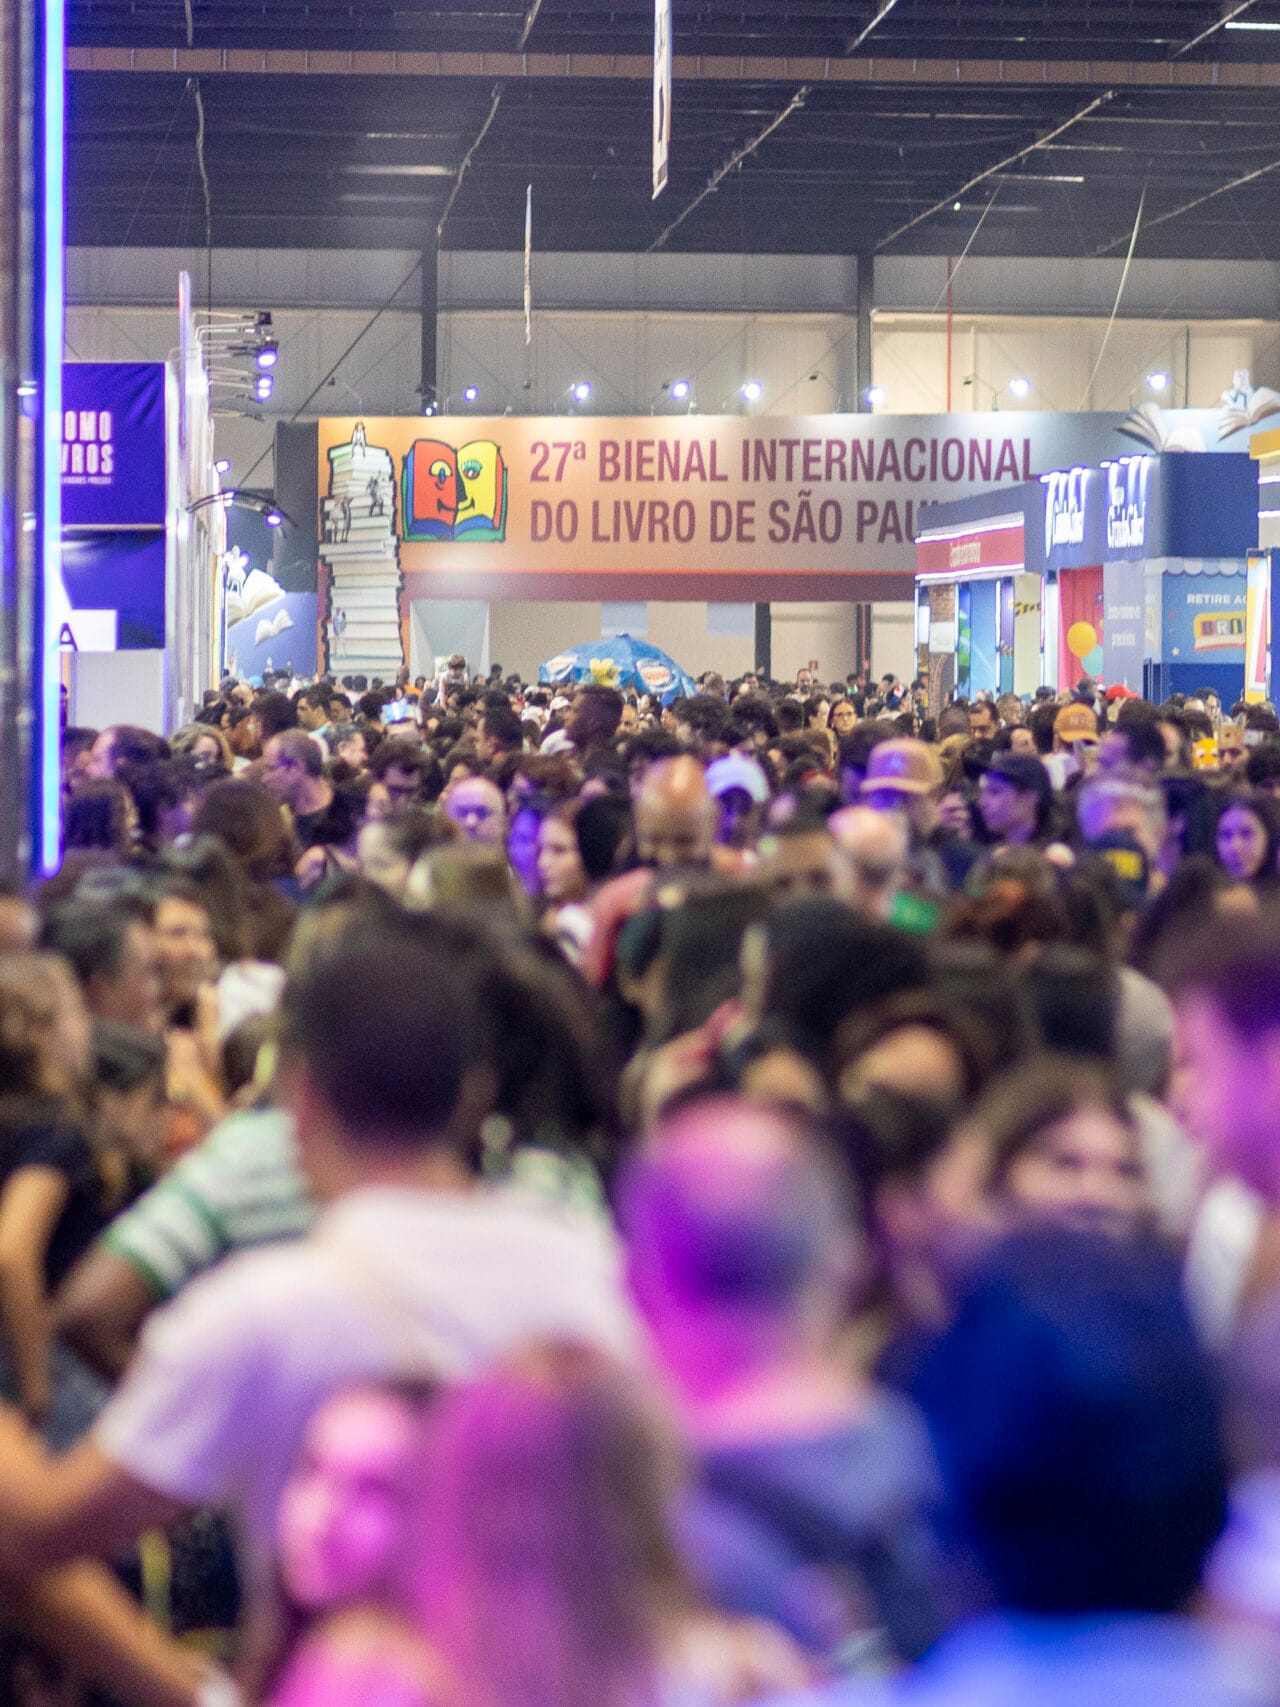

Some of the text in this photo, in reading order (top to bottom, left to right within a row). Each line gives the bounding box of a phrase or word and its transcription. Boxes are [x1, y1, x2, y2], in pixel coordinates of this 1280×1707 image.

[530, 438, 1042, 483] 27ª BIENAL INTERNACIONAL
[531, 498, 578, 543] DO
[592, 498, 696, 543] LIVRO
[710, 499, 756, 543] DE
[768, 488, 842, 543] SÃO
[1187, 593, 1231, 604] RETIRE
